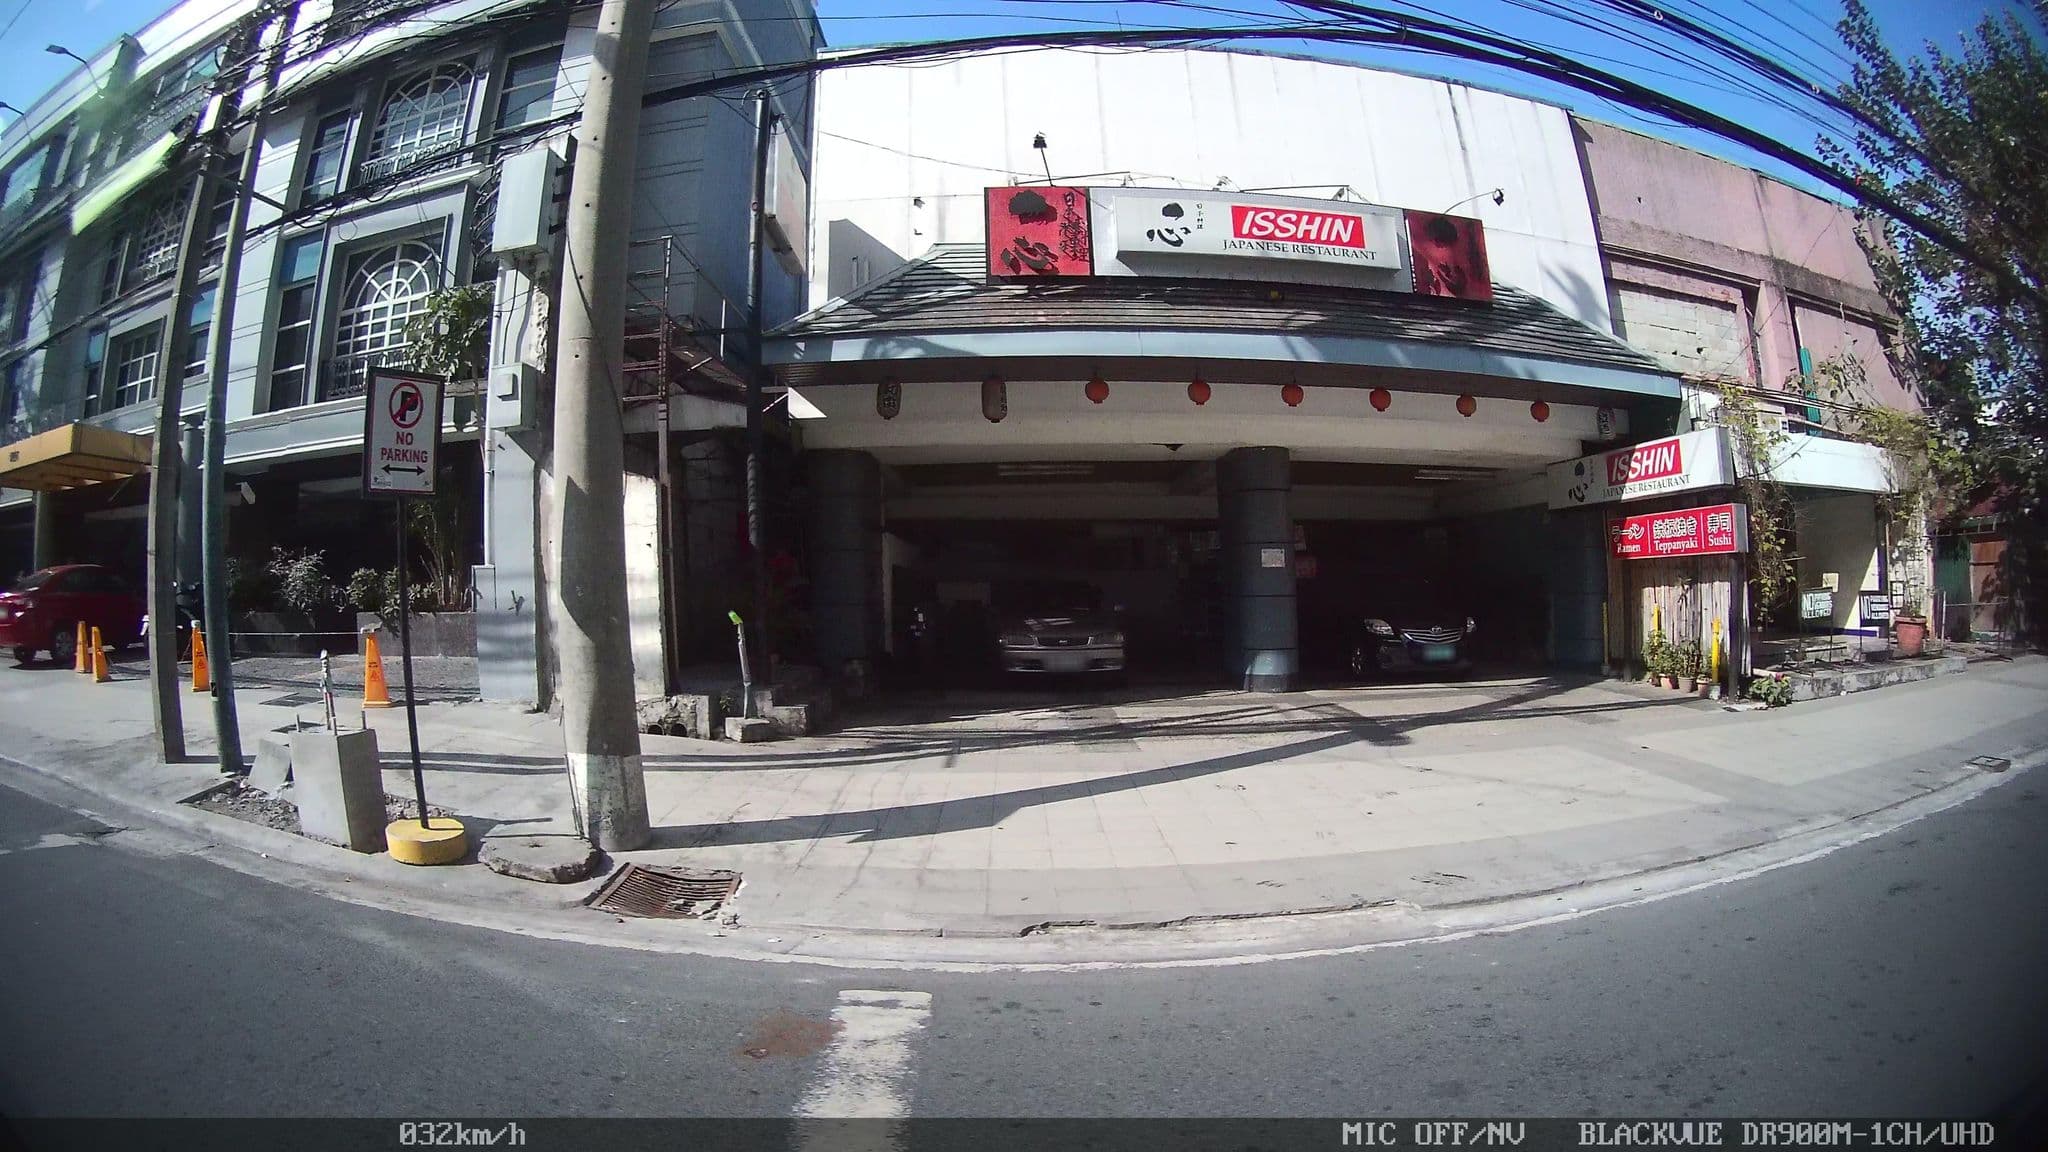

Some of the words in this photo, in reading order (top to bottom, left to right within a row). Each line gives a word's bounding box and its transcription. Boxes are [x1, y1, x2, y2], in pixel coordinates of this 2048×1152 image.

[1242, 211, 1355, 243] ISSHIN
[1223, 239, 1289, 253] JAPANESE
[1292, 244, 1377, 261] RESTAURANT
[396, 431, 414, 446] NO
[380, 447, 429, 463] PARKING
[1612, 444, 1676, 483] ISSHIN
[1602, 483, 1638, 498] JAPANESE
[1639, 474, 1691, 492] RESTAURANT
[1706, 512, 1732, 534] 寿司
[1612, 523, 1645, 542] ラーメン
[1708, 533, 1732, 547] Sushi
[1616, 541, 1641, 554] Ramen
[1653, 537, 1699, 554] Teppanyaki
[1802, 593, 1815, 611] NO
